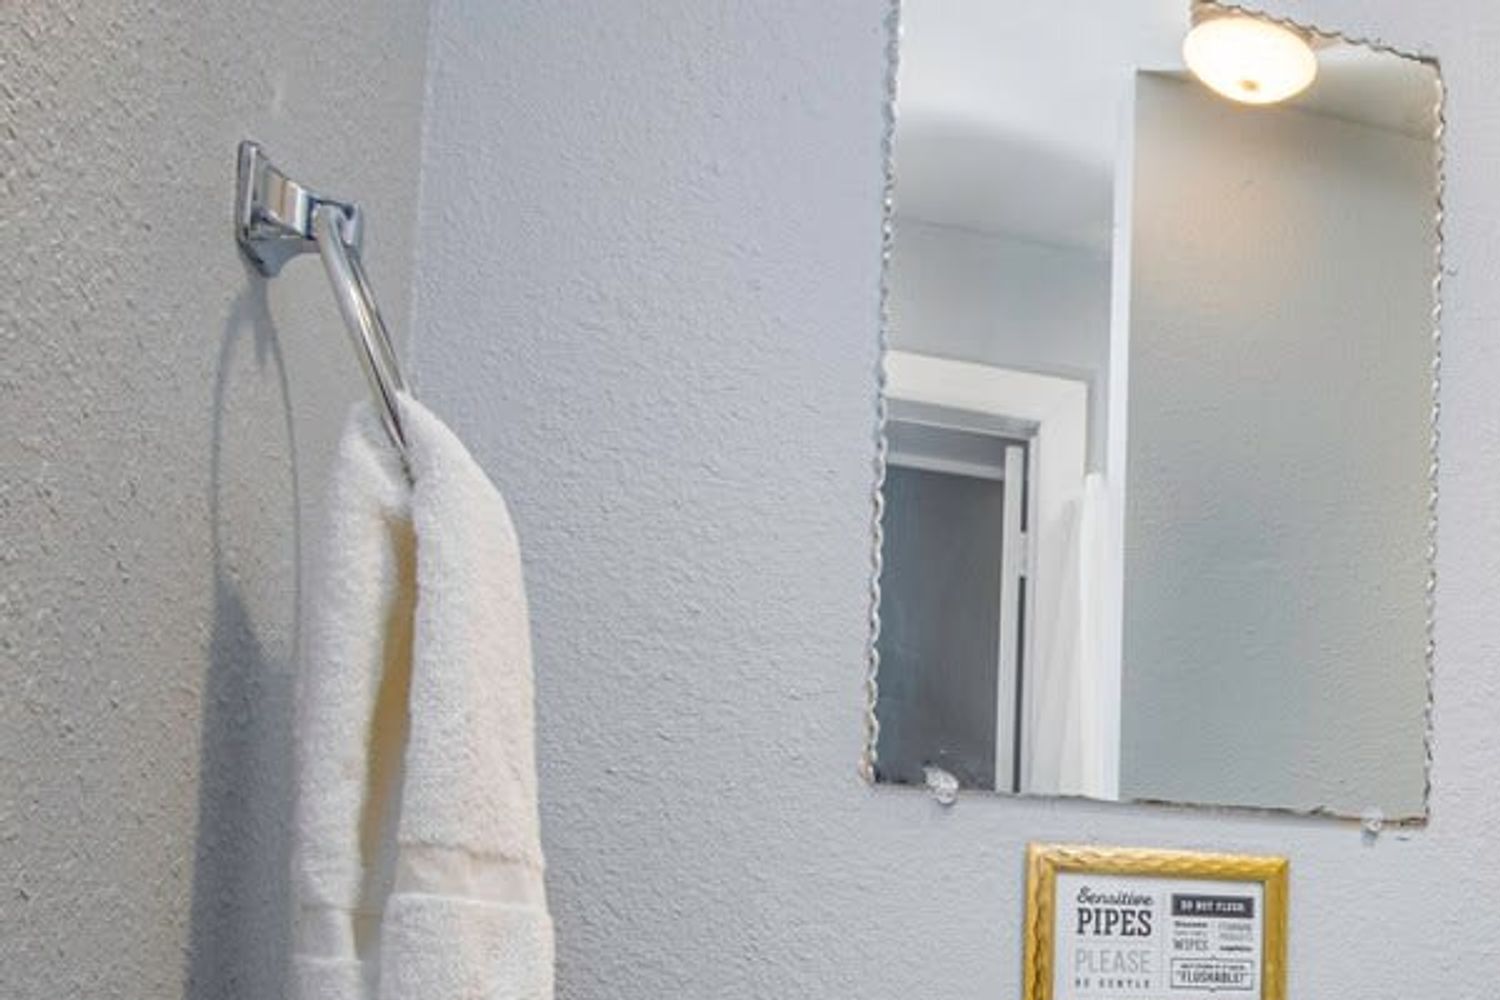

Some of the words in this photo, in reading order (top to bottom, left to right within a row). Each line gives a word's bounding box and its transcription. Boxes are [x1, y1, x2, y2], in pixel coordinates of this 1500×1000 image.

[1077, 886, 1154, 906] Sensitive
[1077, 908, 1152, 938] PIPES
[1076, 949, 1152, 974] PLEASE
